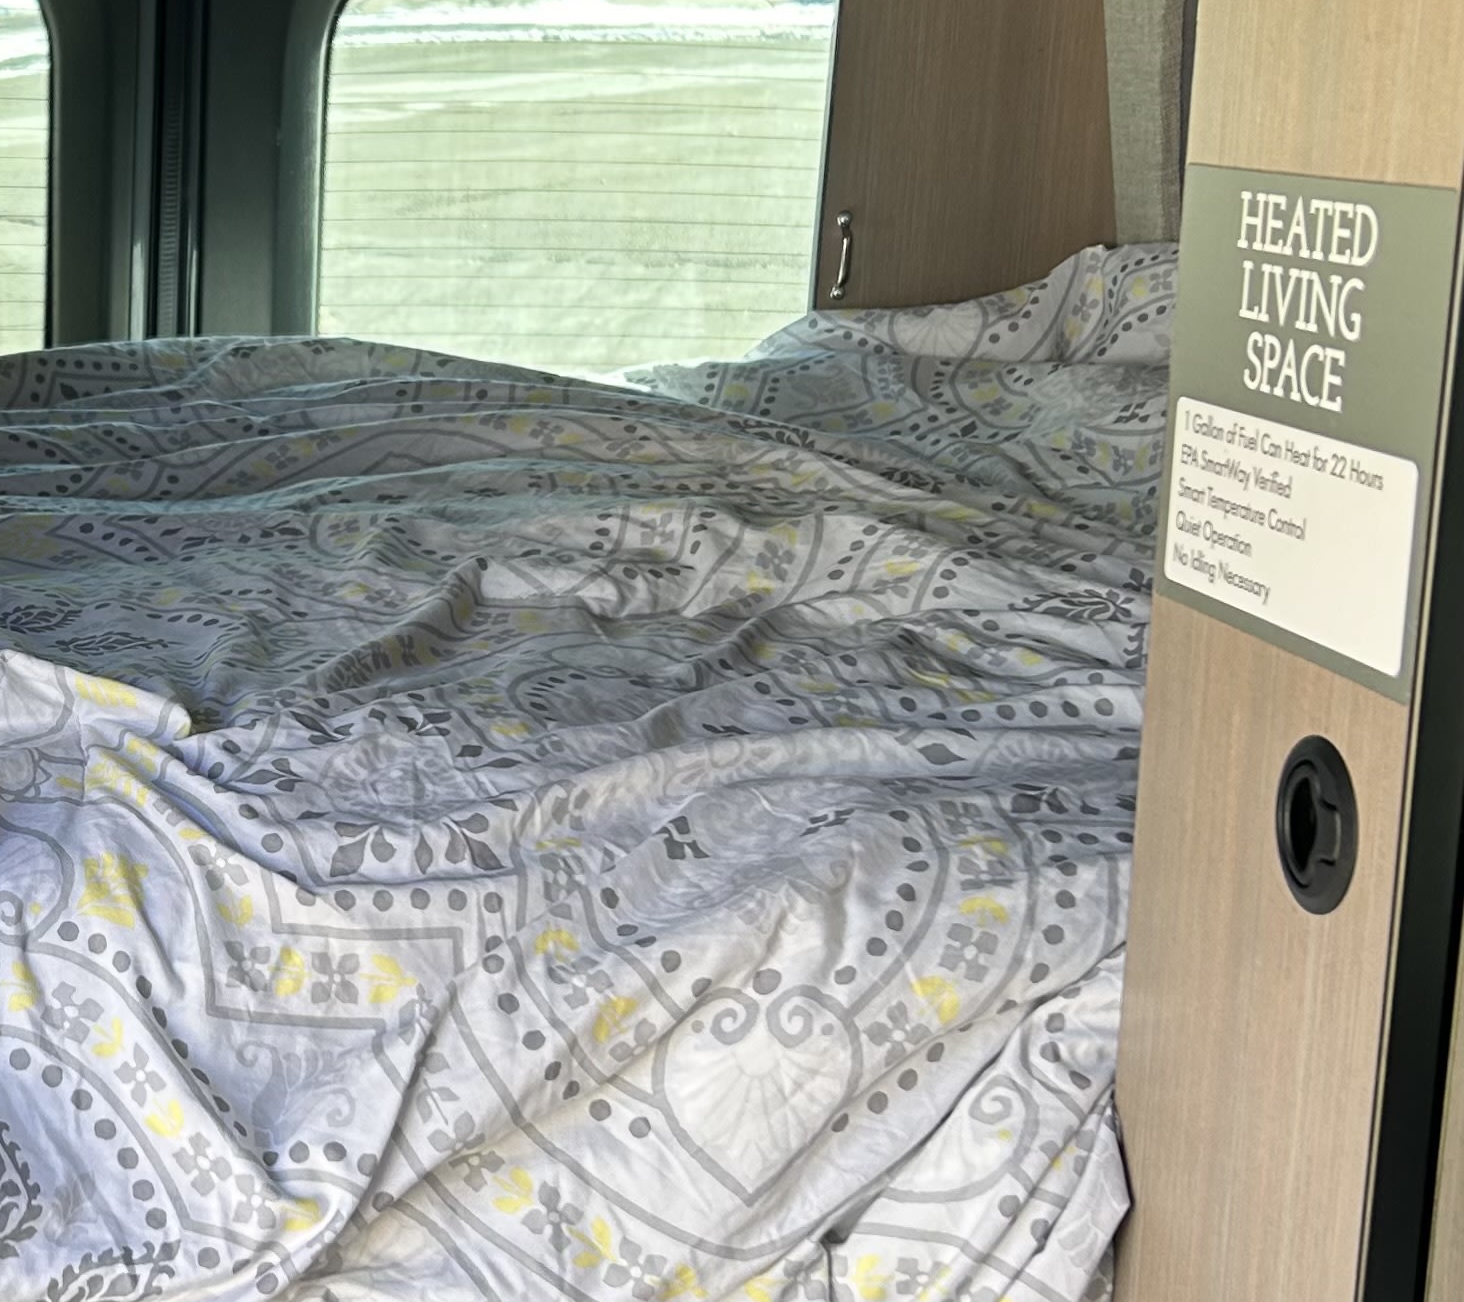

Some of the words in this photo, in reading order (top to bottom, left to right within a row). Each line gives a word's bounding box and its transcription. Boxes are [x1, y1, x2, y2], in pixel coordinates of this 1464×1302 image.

[1237, 191, 1378, 267] HEATED
[1239, 260, 1365, 341] LIVING
[1243, 331, 1346, 413] SPACE
[1181, 443, 1199, 468] EPA
[1253, 466, 1293, 500] Verified
[1192, 414, 1224, 441] Gallon
[1226, 423, 1238, 445] of
[1238, 427, 1260, 451] Fuel
[1260, 433, 1282, 459] Can
[1284, 440, 1310, 467] Heat
[1312, 446, 1328, 472] for
[1330, 453, 1348, 479] 22
[1350, 459, 1384, 491] Hours
[1176, 510, 1202, 537] Quiet
[1203, 520, 1253, 557] Operation
[1178, 477, 1206, 504] Smart
[1207, 487, 1266, 527] Temperature
[1267, 508, 1307, 541] Control
[1173, 543, 1189, 566] No
[1217, 561, 1272, 605] Necessary
